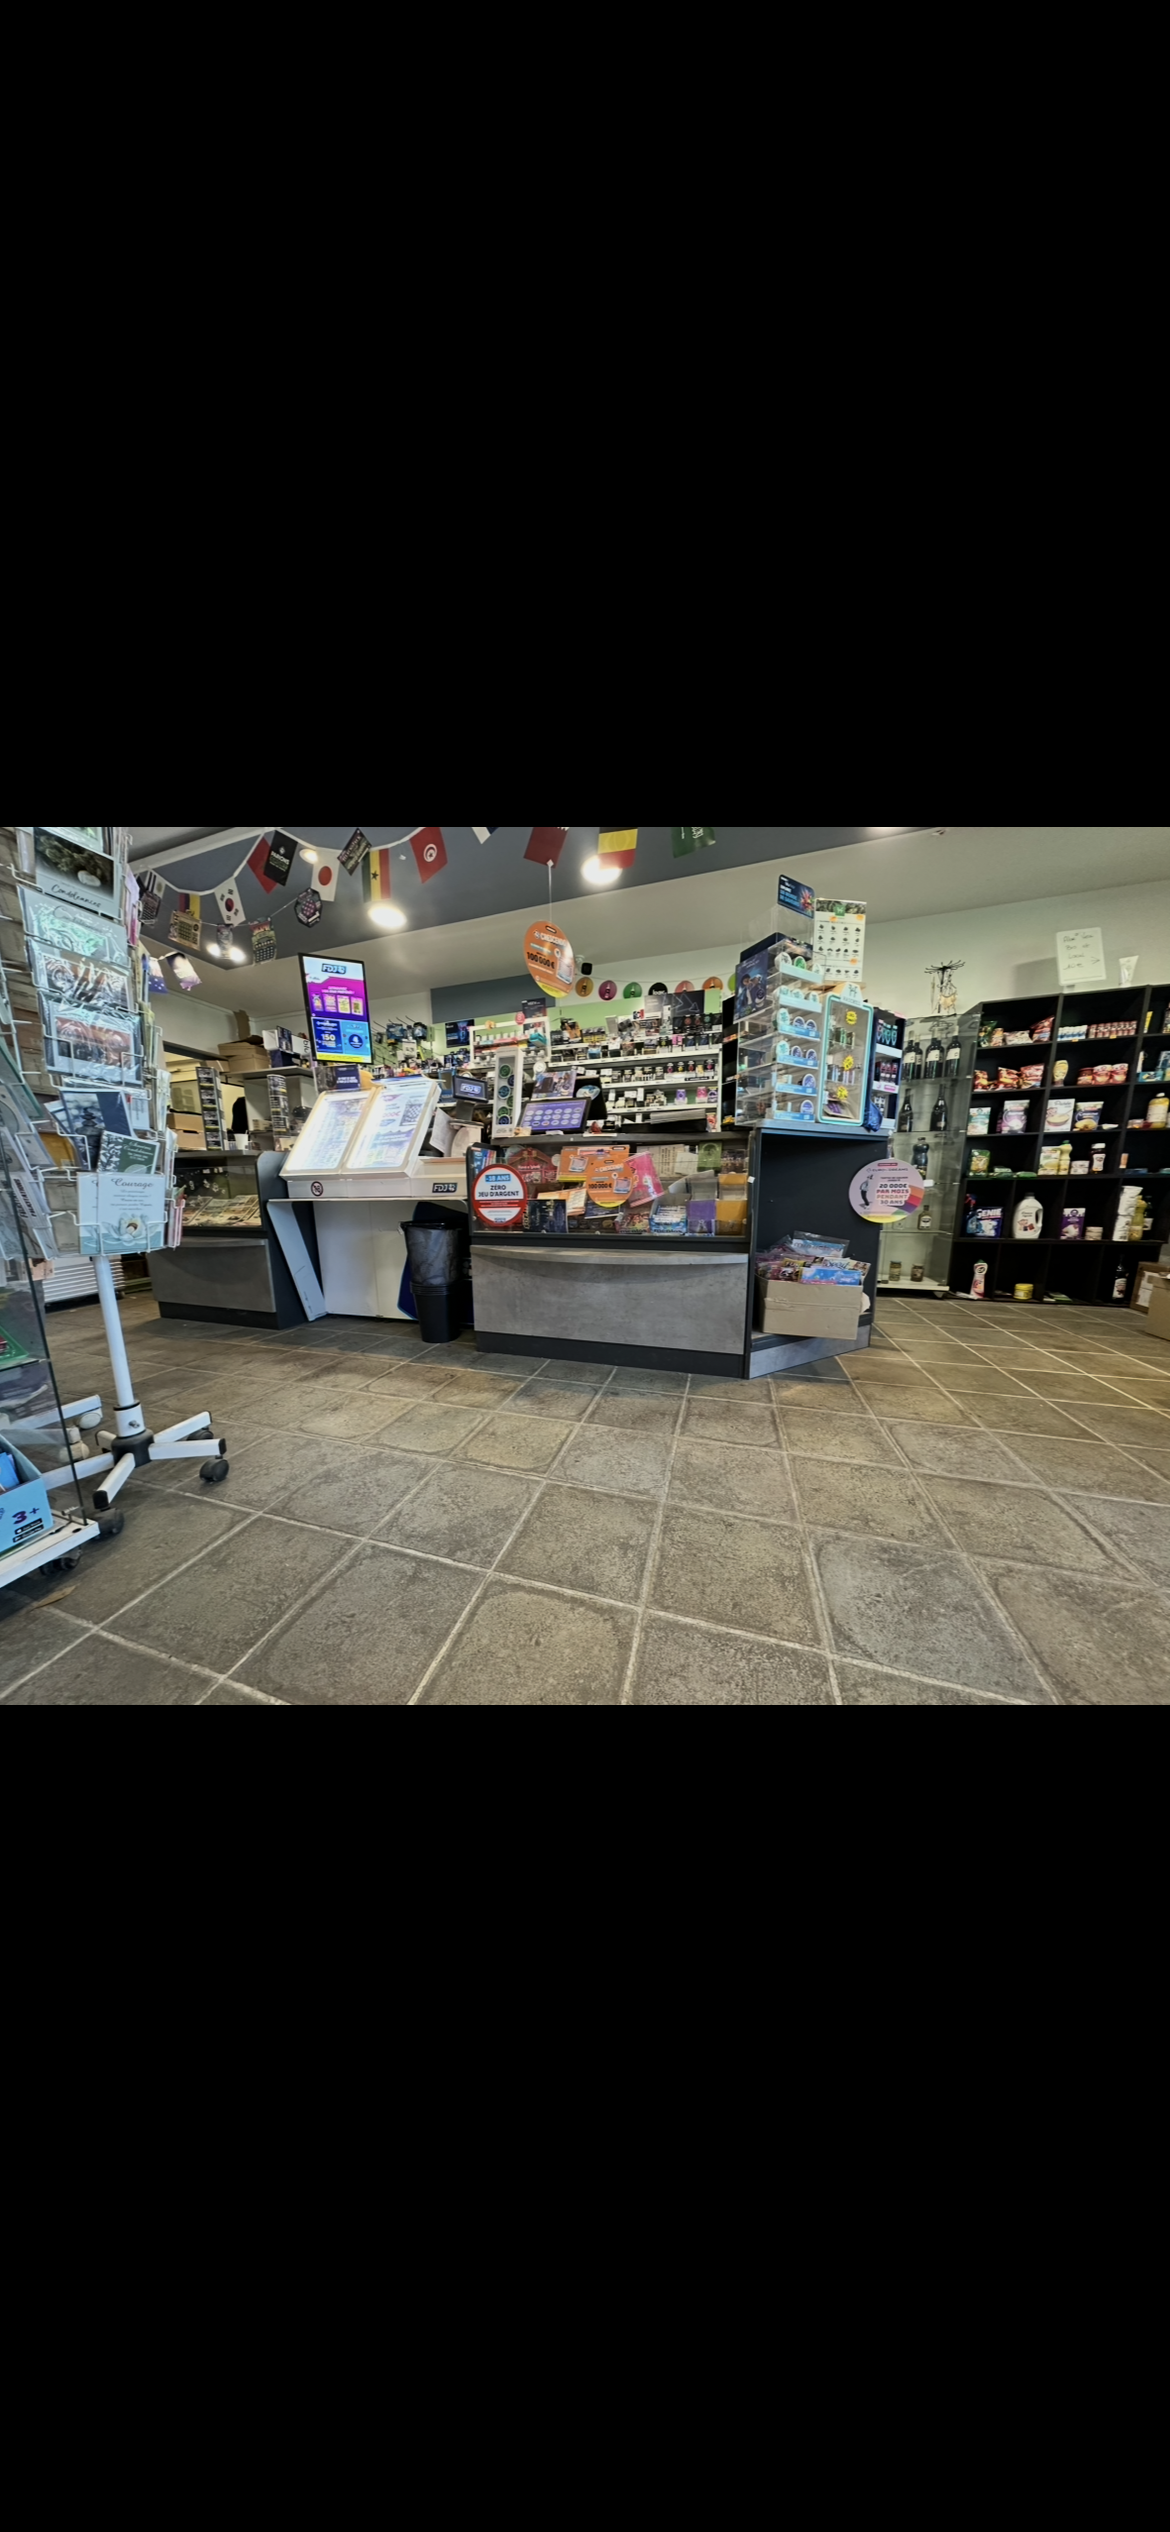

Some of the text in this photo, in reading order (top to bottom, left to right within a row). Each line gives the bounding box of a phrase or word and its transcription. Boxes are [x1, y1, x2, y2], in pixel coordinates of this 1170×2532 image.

[323, 964, 336, 974] FDJ
[111, 1178, 154, 1190] Courage
[433, 1184, 448, 1192] FDJ
